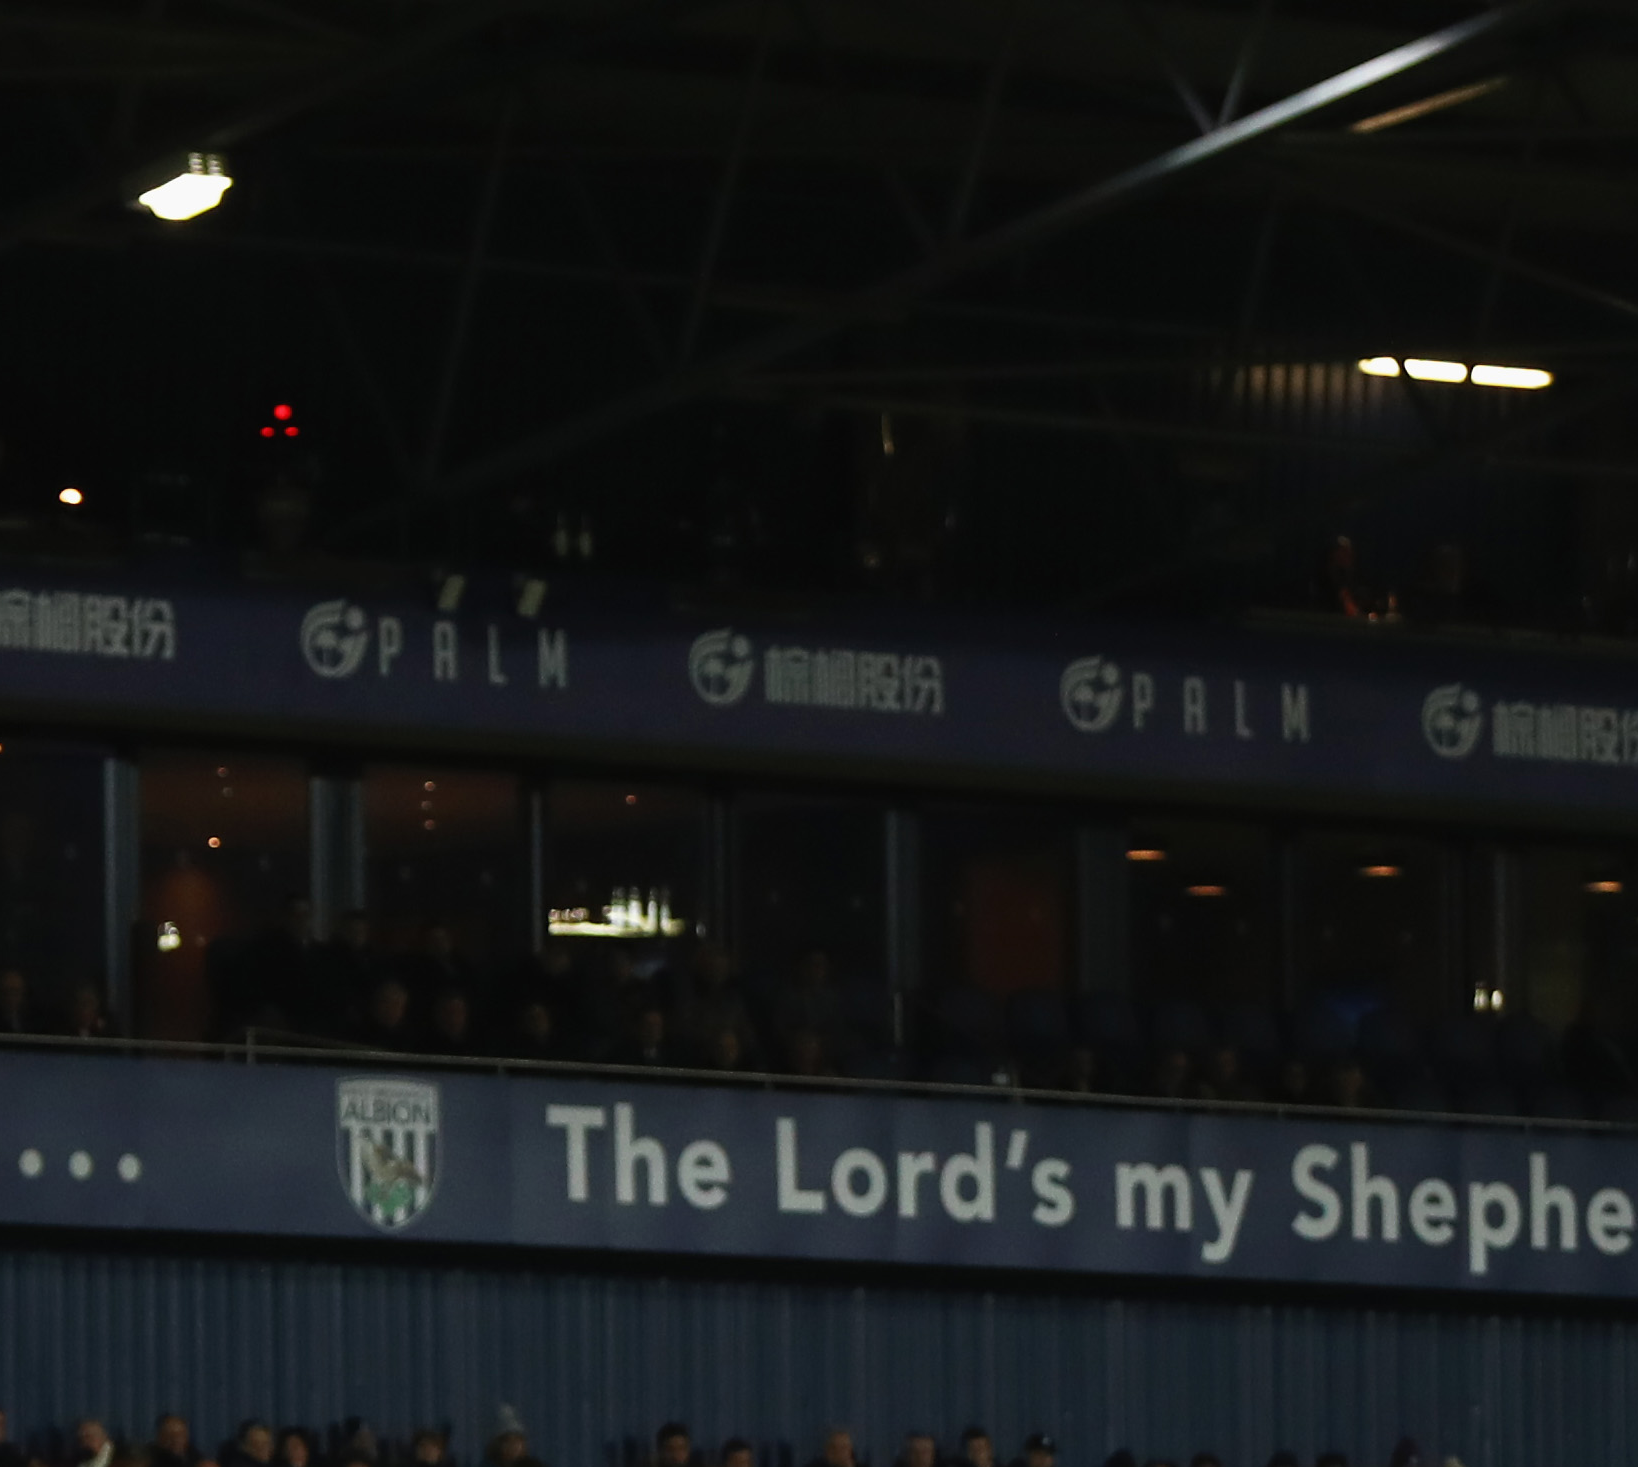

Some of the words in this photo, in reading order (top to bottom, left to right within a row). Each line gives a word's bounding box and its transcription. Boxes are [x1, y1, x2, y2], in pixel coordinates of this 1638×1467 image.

[378, 617, 567, 689] PALM
[1132, 673, 1308, 740] PALM
[342, 1098, 430, 1124] ALBION
[547, 1104, 730, 1208] The
[777, 1118, 1073, 1225] Lord's
[1116, 1164, 1252, 1262] my
